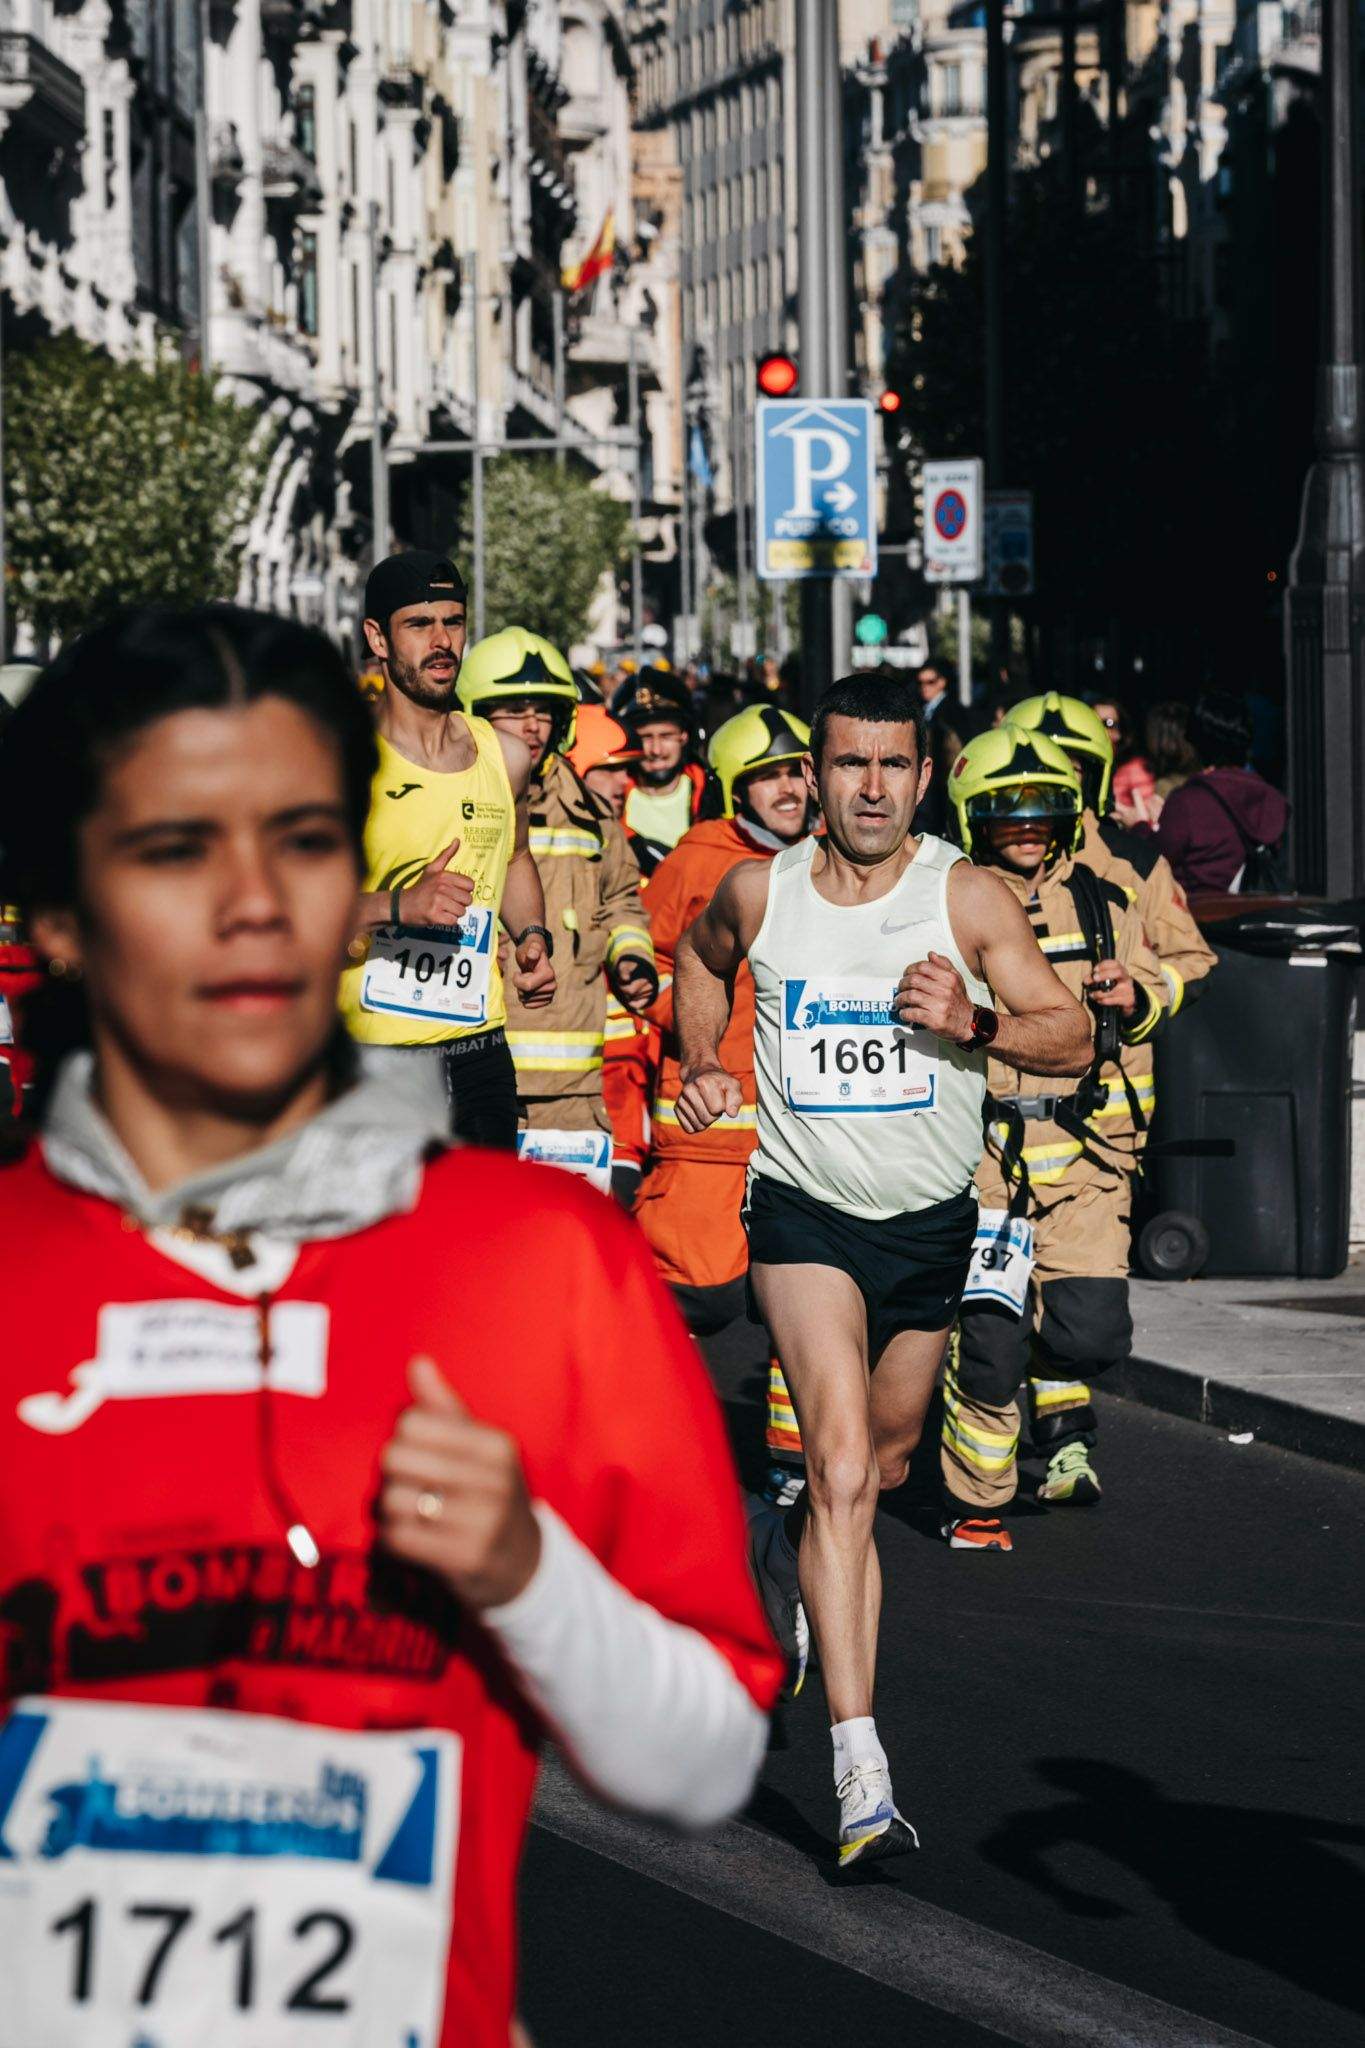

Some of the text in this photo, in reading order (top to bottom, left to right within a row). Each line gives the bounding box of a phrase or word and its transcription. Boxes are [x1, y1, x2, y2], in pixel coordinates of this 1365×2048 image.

[783, 428, 852, 518] P
[394, 948, 472, 988] 1019
[810, 1038, 907, 1075] 1661
[50, 1895, 356, 2013] 1712
